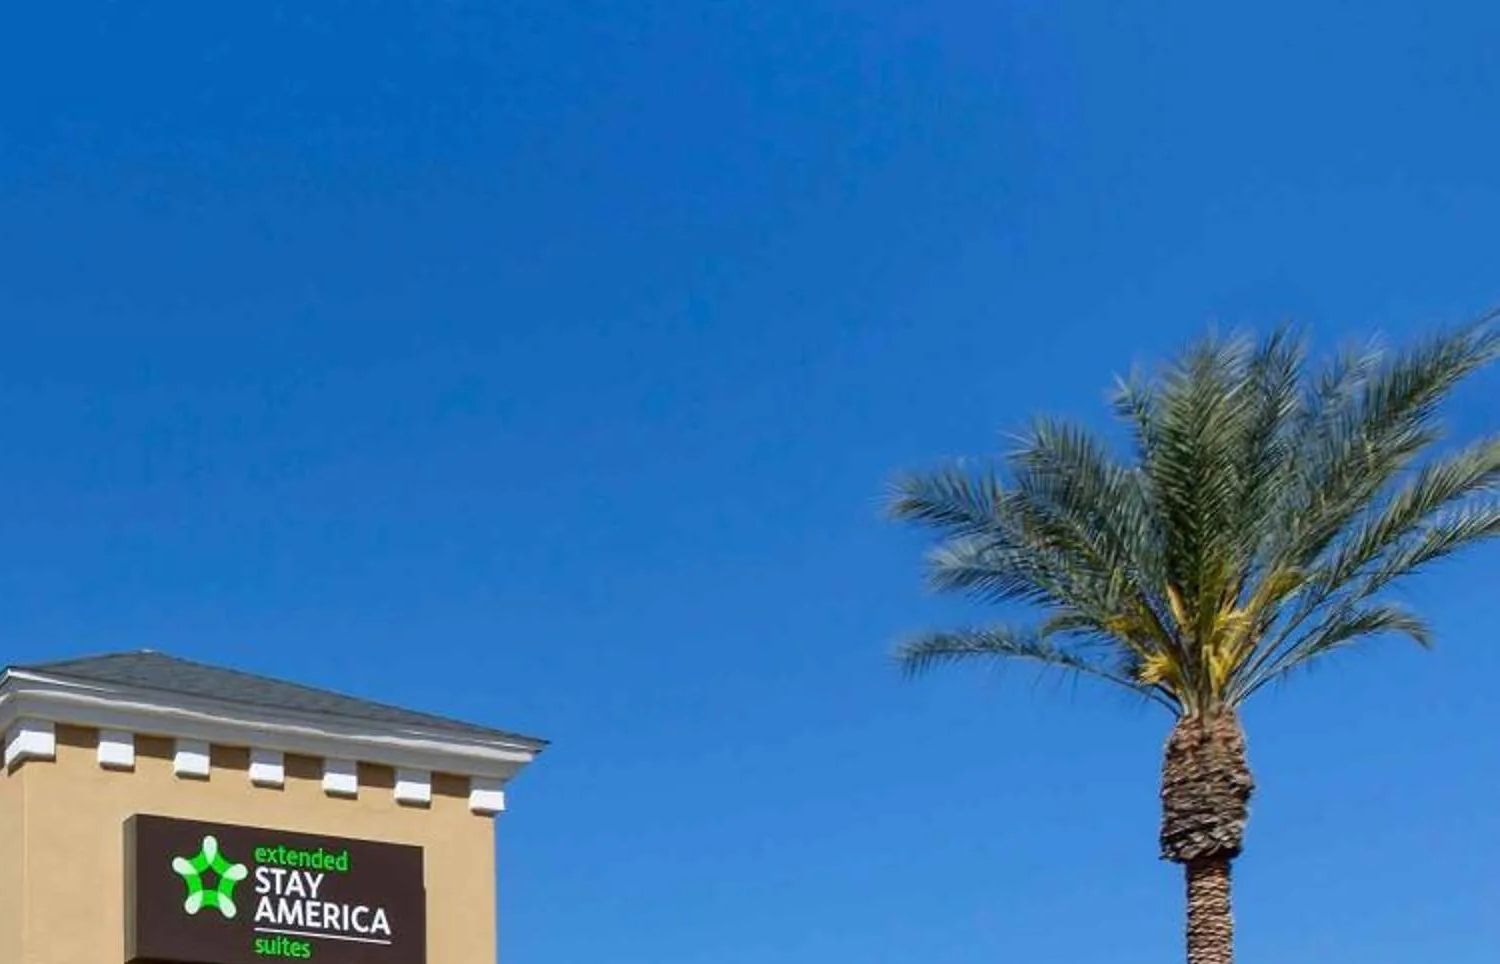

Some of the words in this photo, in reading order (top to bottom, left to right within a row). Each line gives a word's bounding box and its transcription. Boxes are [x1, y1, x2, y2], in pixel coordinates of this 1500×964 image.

[254, 846, 349, 871] extended
[255, 866, 325, 899] STAY
[254, 895, 392, 936] AMERICA
[254, 936, 312, 959] suites
